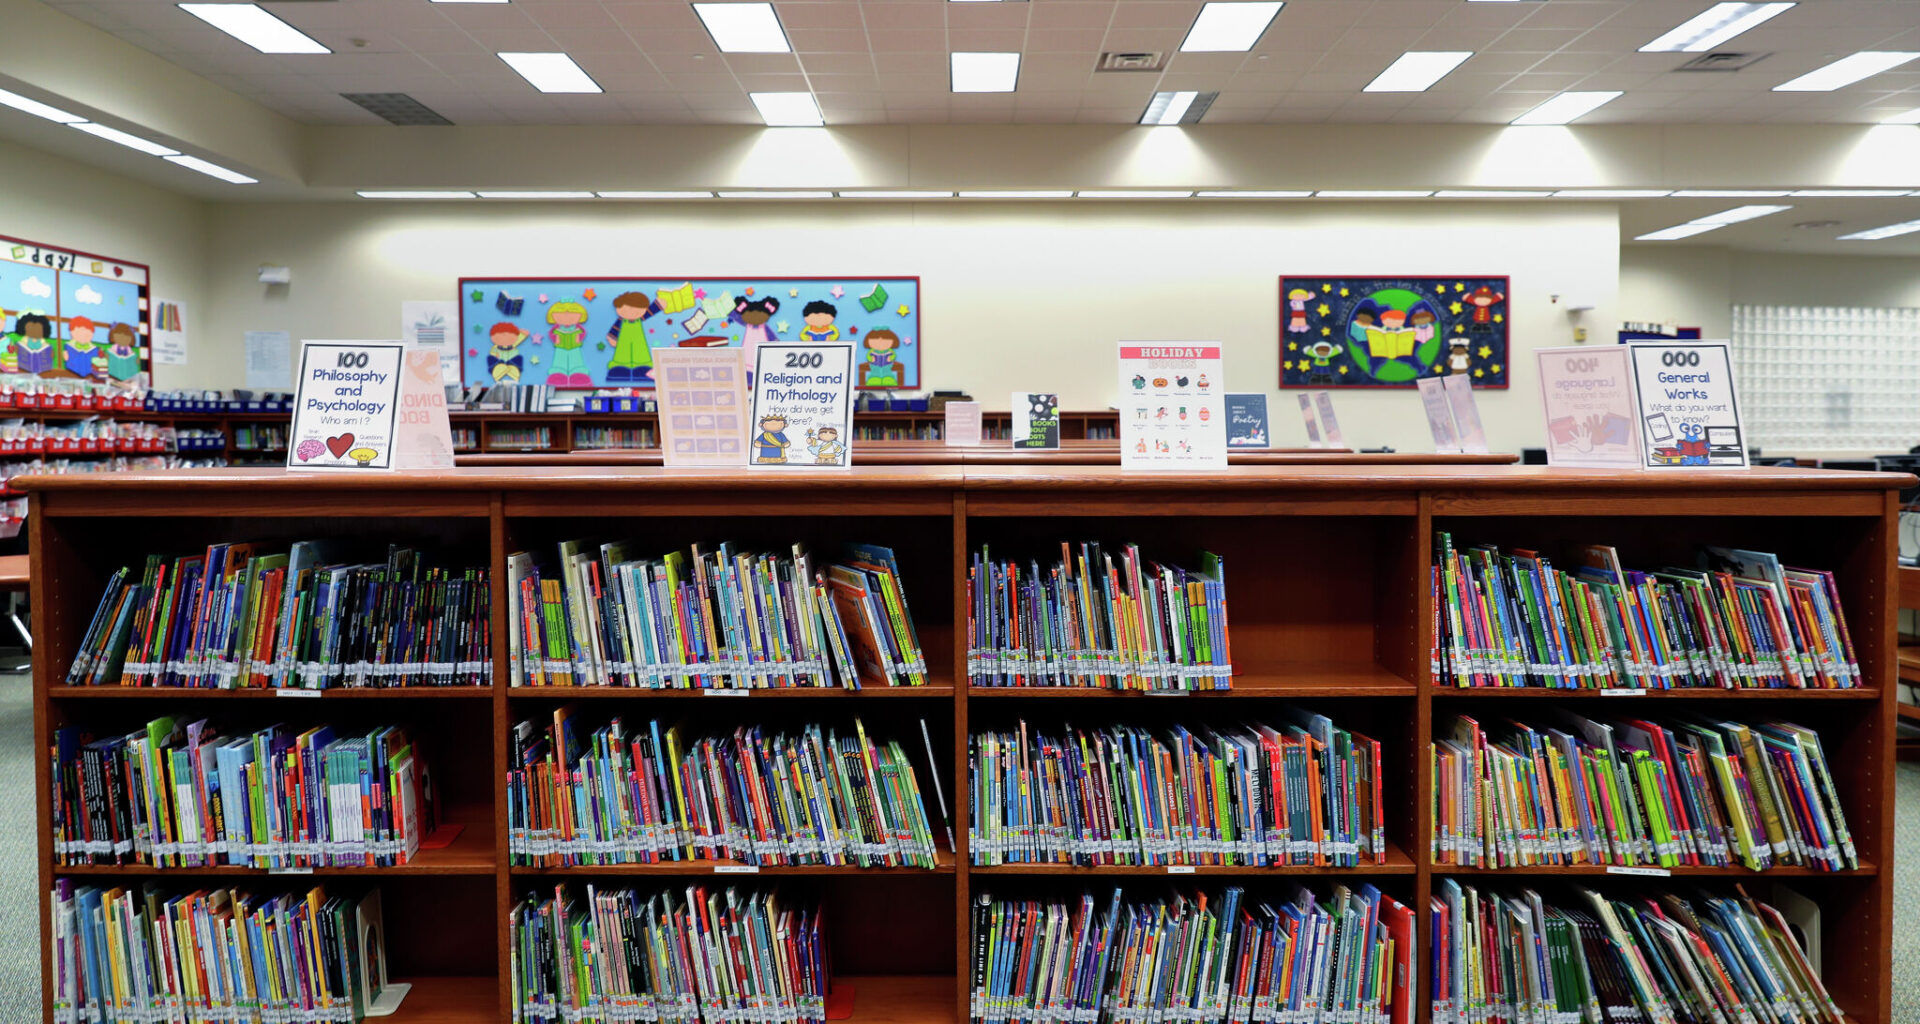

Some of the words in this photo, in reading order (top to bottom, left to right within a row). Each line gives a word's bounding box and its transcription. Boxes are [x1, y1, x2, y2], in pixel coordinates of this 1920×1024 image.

[31, 249, 76, 272] day!
[337, 351, 369, 368] 100
[785, 352, 823, 368] 200
[1141, 348, 1204, 358] HOLIDAY
[1661, 350, 1700, 368] 000
[313, 369, 387, 384] Philosophy
[764, 372, 812, 386] Religion
[816, 372, 842, 384] and
[1657, 371, 1710, 383] General
[335, 385, 362, 396] and
[766, 389, 837, 403] Mythology
[1665, 388, 1708, 400] Works
[307, 398, 386, 414] Psychology
[768, 405, 788, 413] How
[790, 405, 802, 413] did
[820, 406, 834, 415] get
[1688, 405, 1705, 413] you
[321, 416, 341, 425] Who
[1232, 414, 1261, 428] Poetry
[1681, 415, 1710, 424] know?
[638, 778, 647, 805] FREEDOM
[1167, 782, 1175, 809] rescues!
[1251, 769, 1261, 809] MELTDOWN
[978, 974, 982, 983] OF
